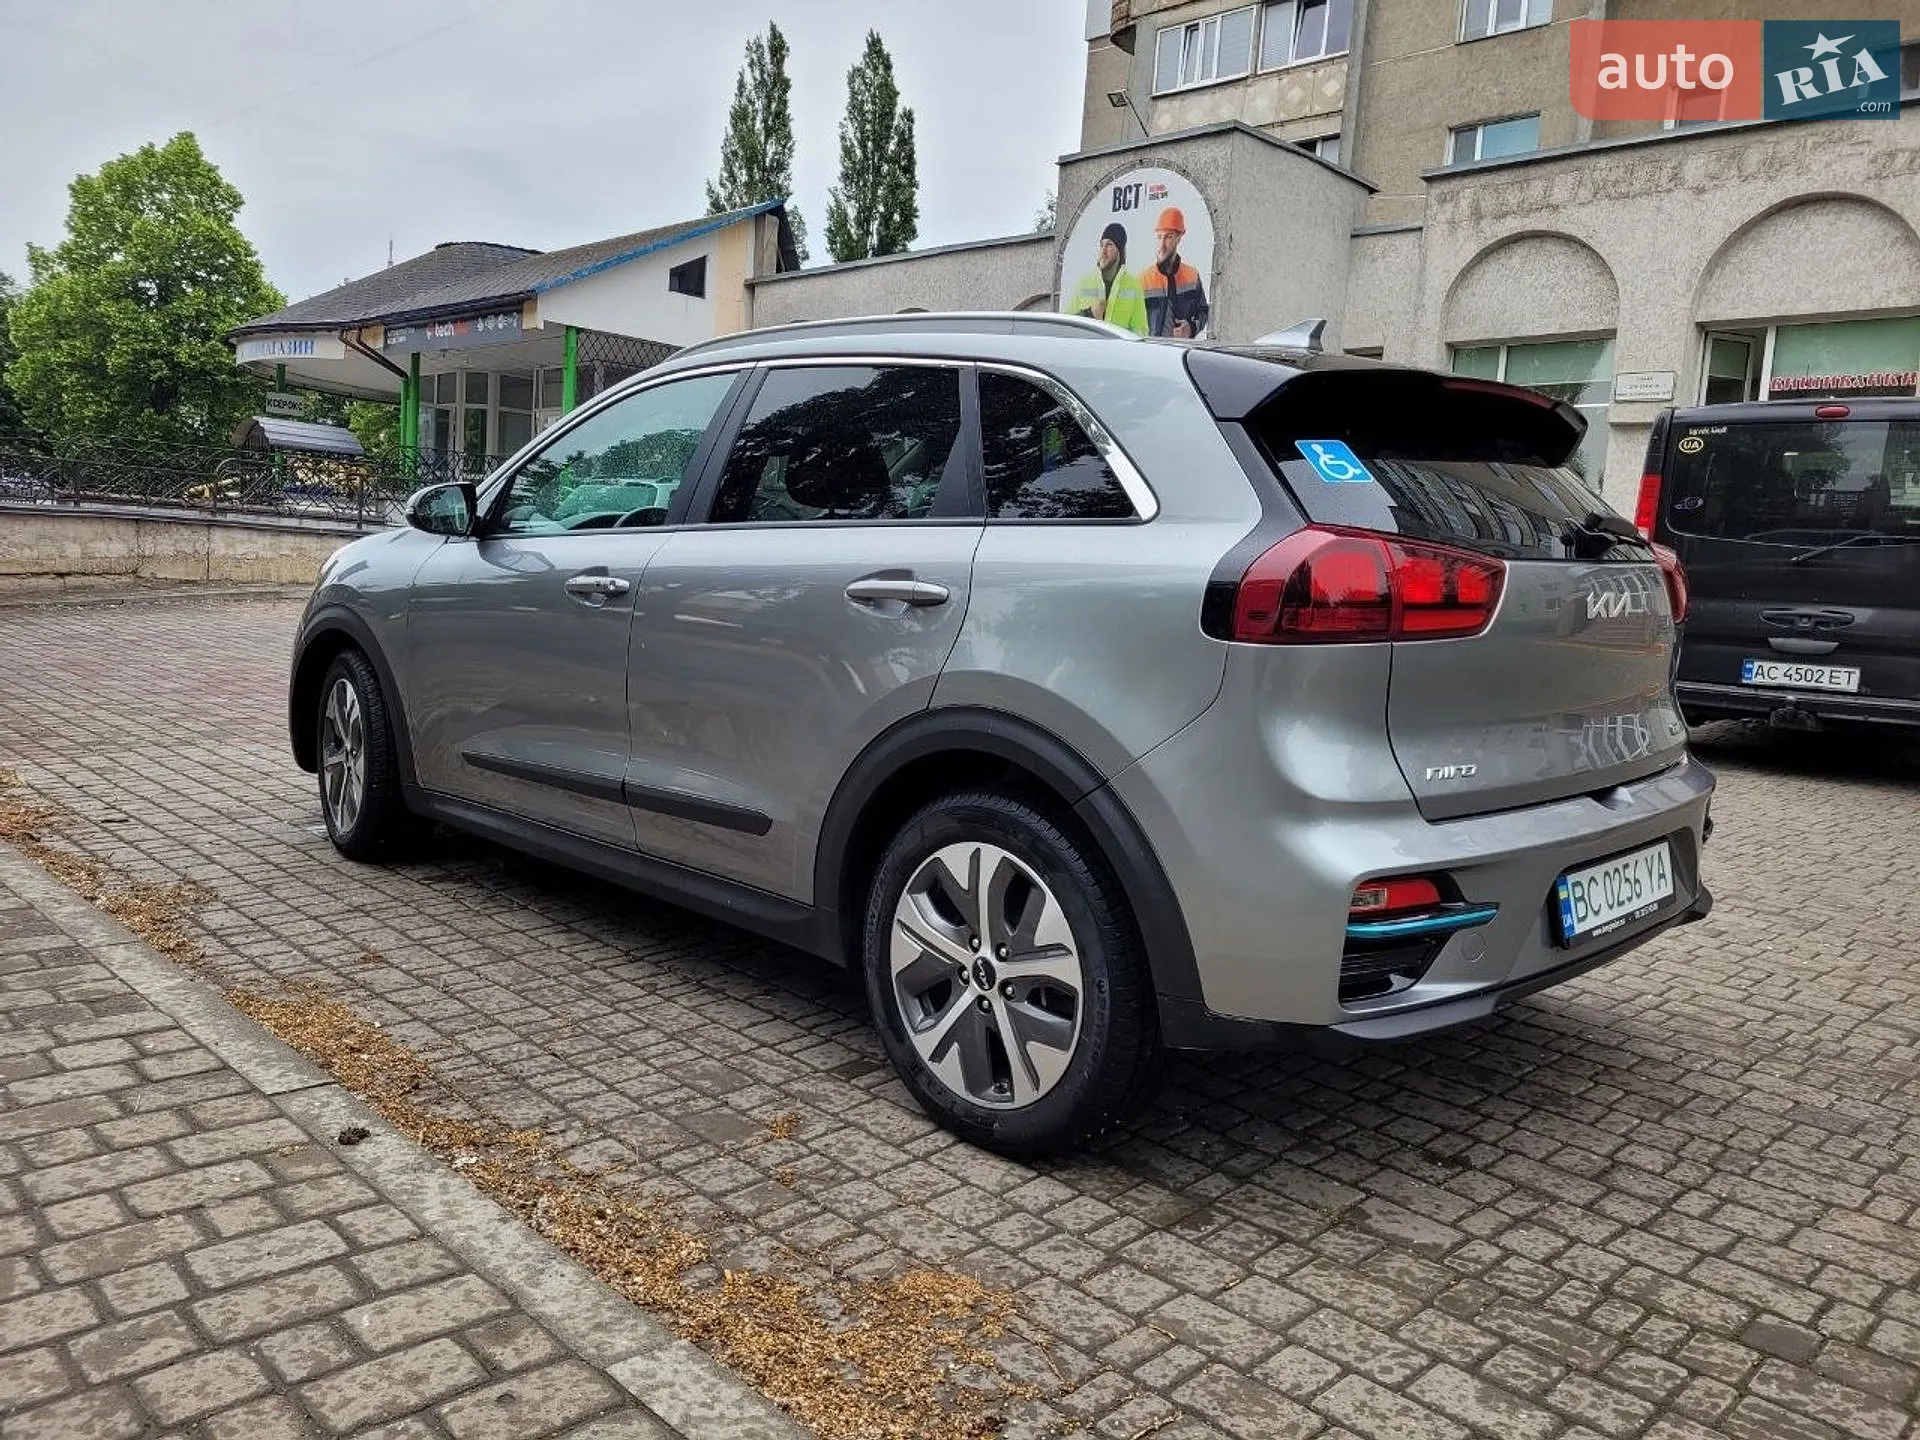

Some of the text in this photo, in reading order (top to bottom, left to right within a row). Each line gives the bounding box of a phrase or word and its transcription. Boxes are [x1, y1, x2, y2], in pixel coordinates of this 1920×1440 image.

[1753, 664, 1779, 681] AC
[1783, 665, 1825, 684] 4502
[1828, 669, 1857, 686] ET
[1426, 764, 1478, 781] niro
[1571, 850, 1668, 924] BC 0256 YA
